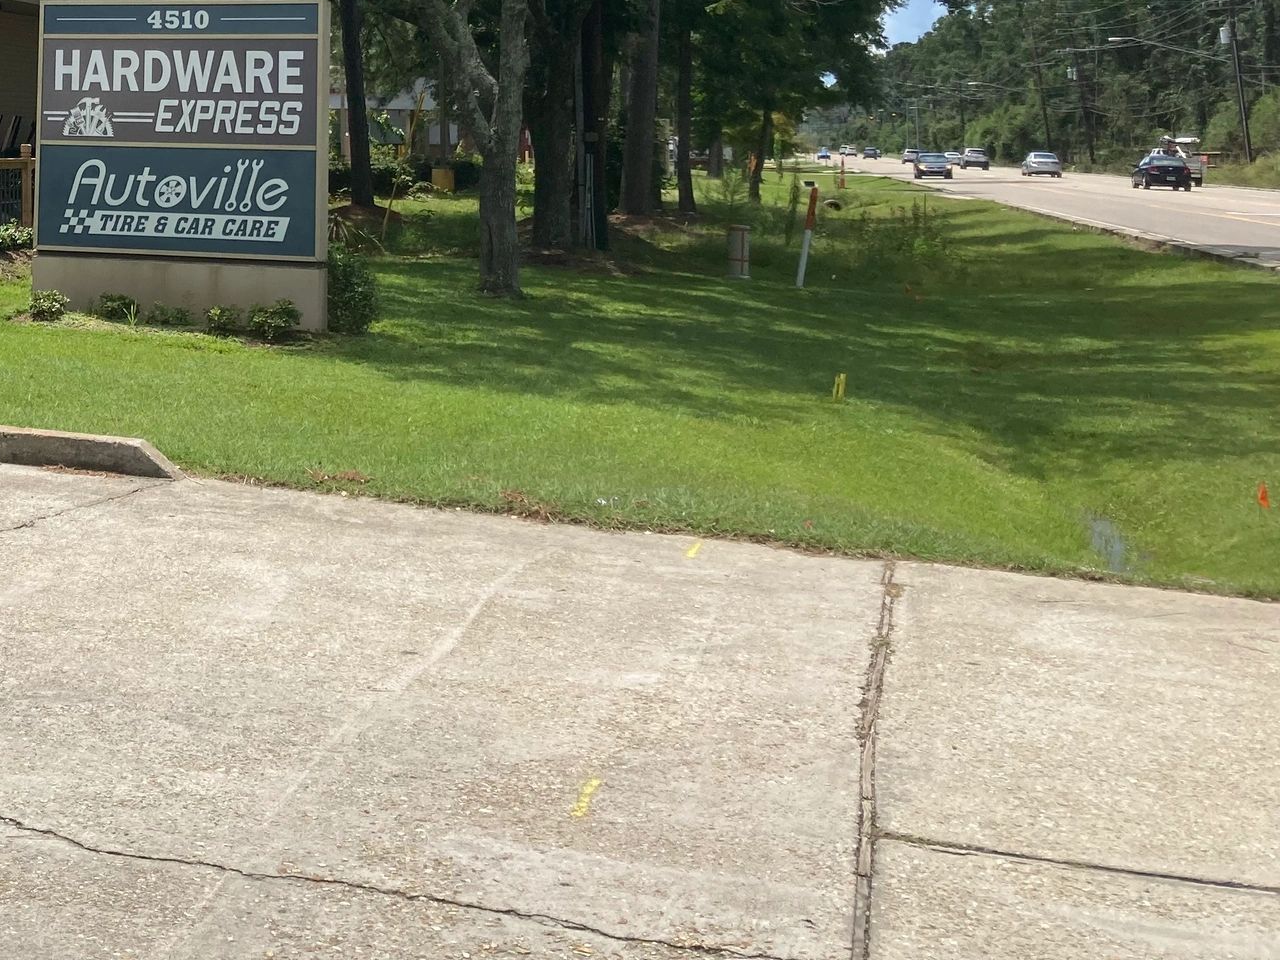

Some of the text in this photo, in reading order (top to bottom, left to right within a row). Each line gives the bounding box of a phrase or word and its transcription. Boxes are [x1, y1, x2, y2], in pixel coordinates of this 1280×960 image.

[147, 9, 210, 30] 4510
[54, 49, 304, 94] HARDWARE
[155, 99, 302, 135] EXPRESS
[68, 158, 289, 212] Autoville
[99, 214, 279, 238] TIRE & CAR CARE
